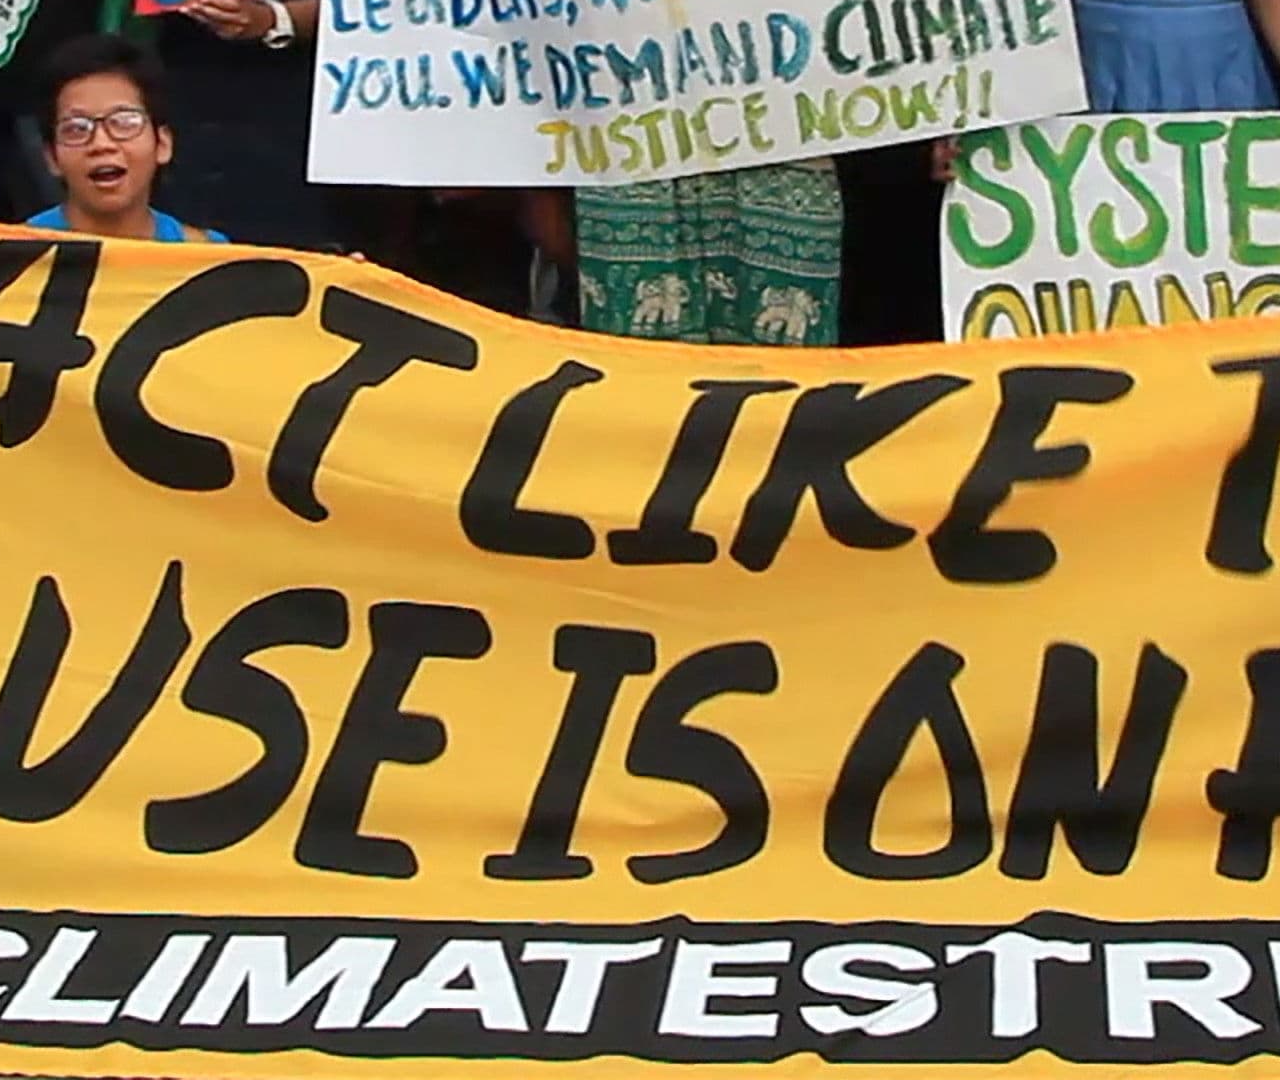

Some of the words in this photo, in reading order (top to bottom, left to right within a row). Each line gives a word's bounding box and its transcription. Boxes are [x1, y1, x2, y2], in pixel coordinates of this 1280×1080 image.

[537, 91, 776, 175] JUSTICE
[544, 12, 813, 110] DEMAND
[457, 357, 1134, 583] LIKE
[483, 623, 778, 884] IS
[822, 640, 1189, 883] ON
